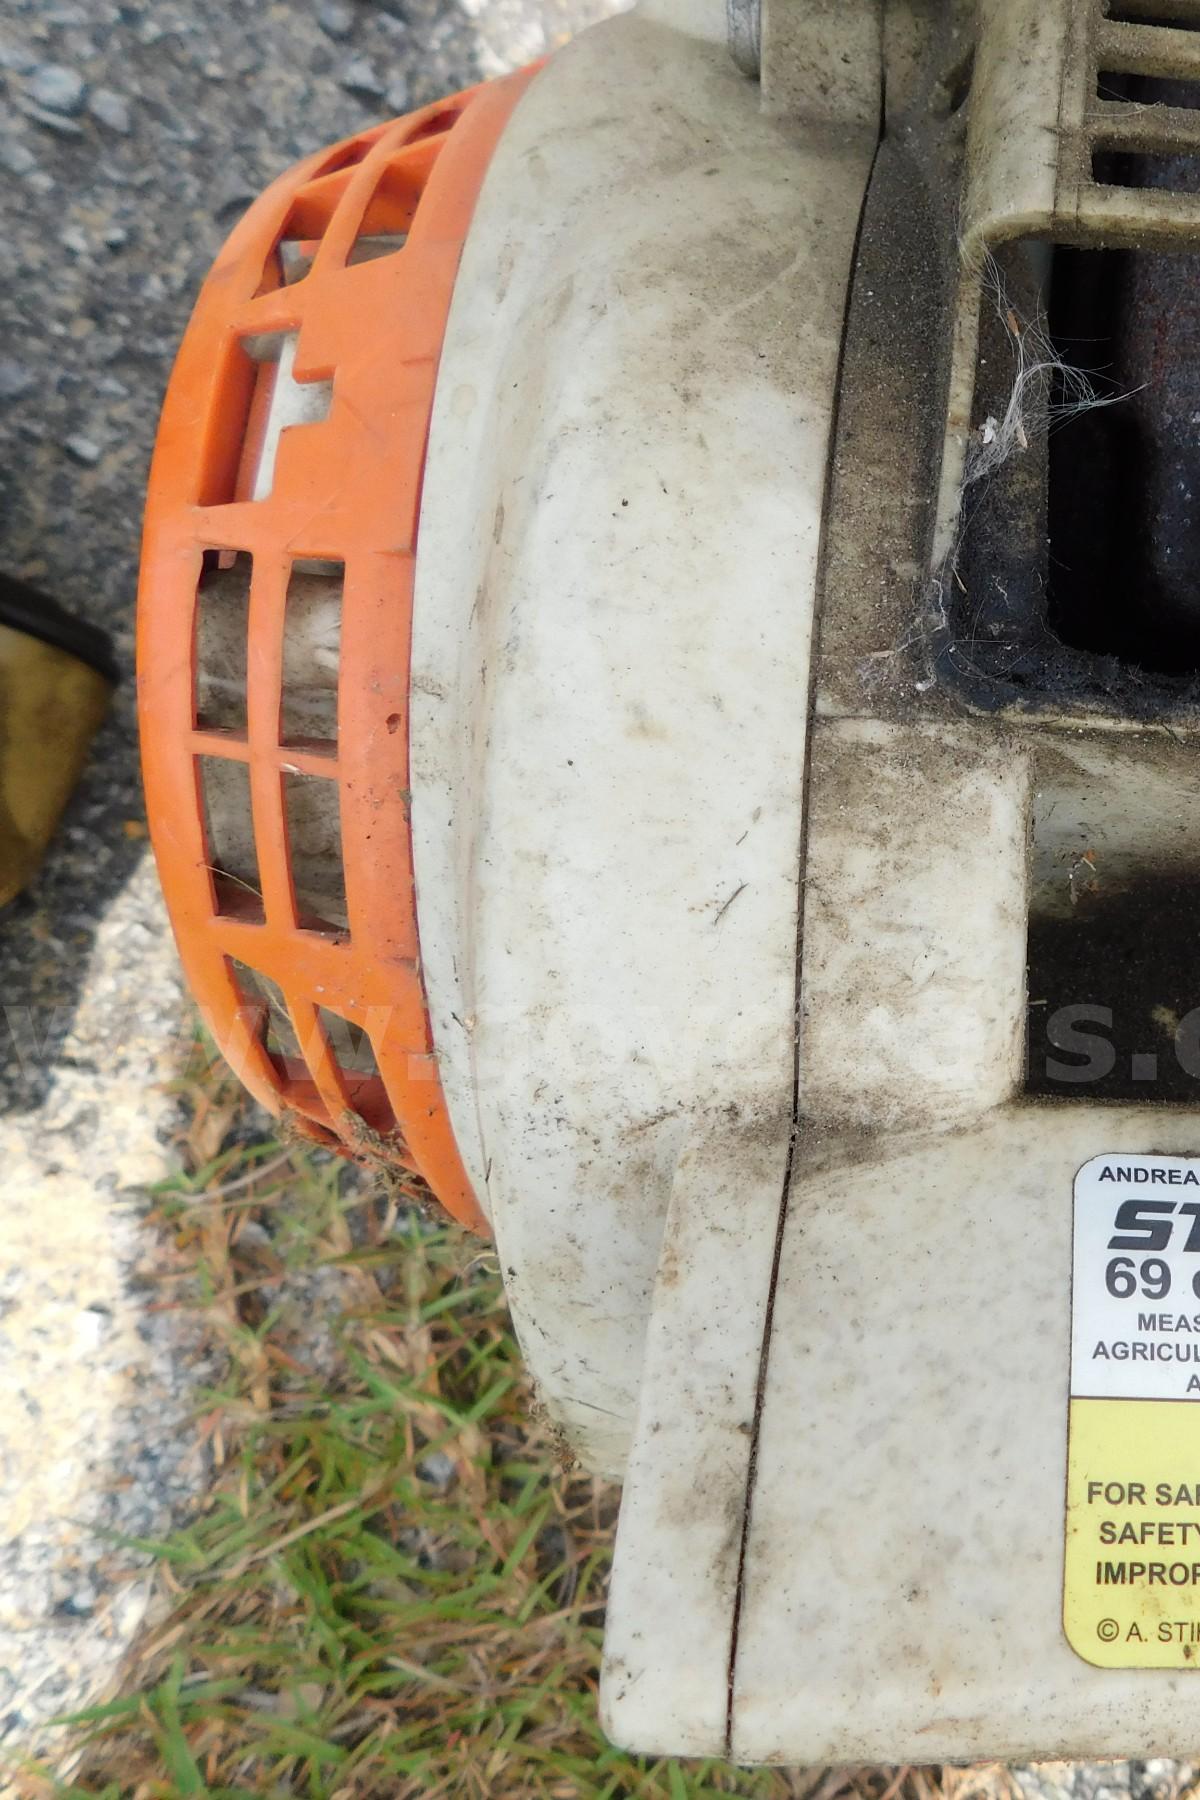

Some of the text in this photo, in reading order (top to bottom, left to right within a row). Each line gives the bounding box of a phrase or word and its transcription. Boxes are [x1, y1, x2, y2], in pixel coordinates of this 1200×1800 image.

[1105, 1256, 1172, 1301] 69
[1086, 1482, 1146, 1507] FOR
[1126, 1620, 1149, 1643] A.
